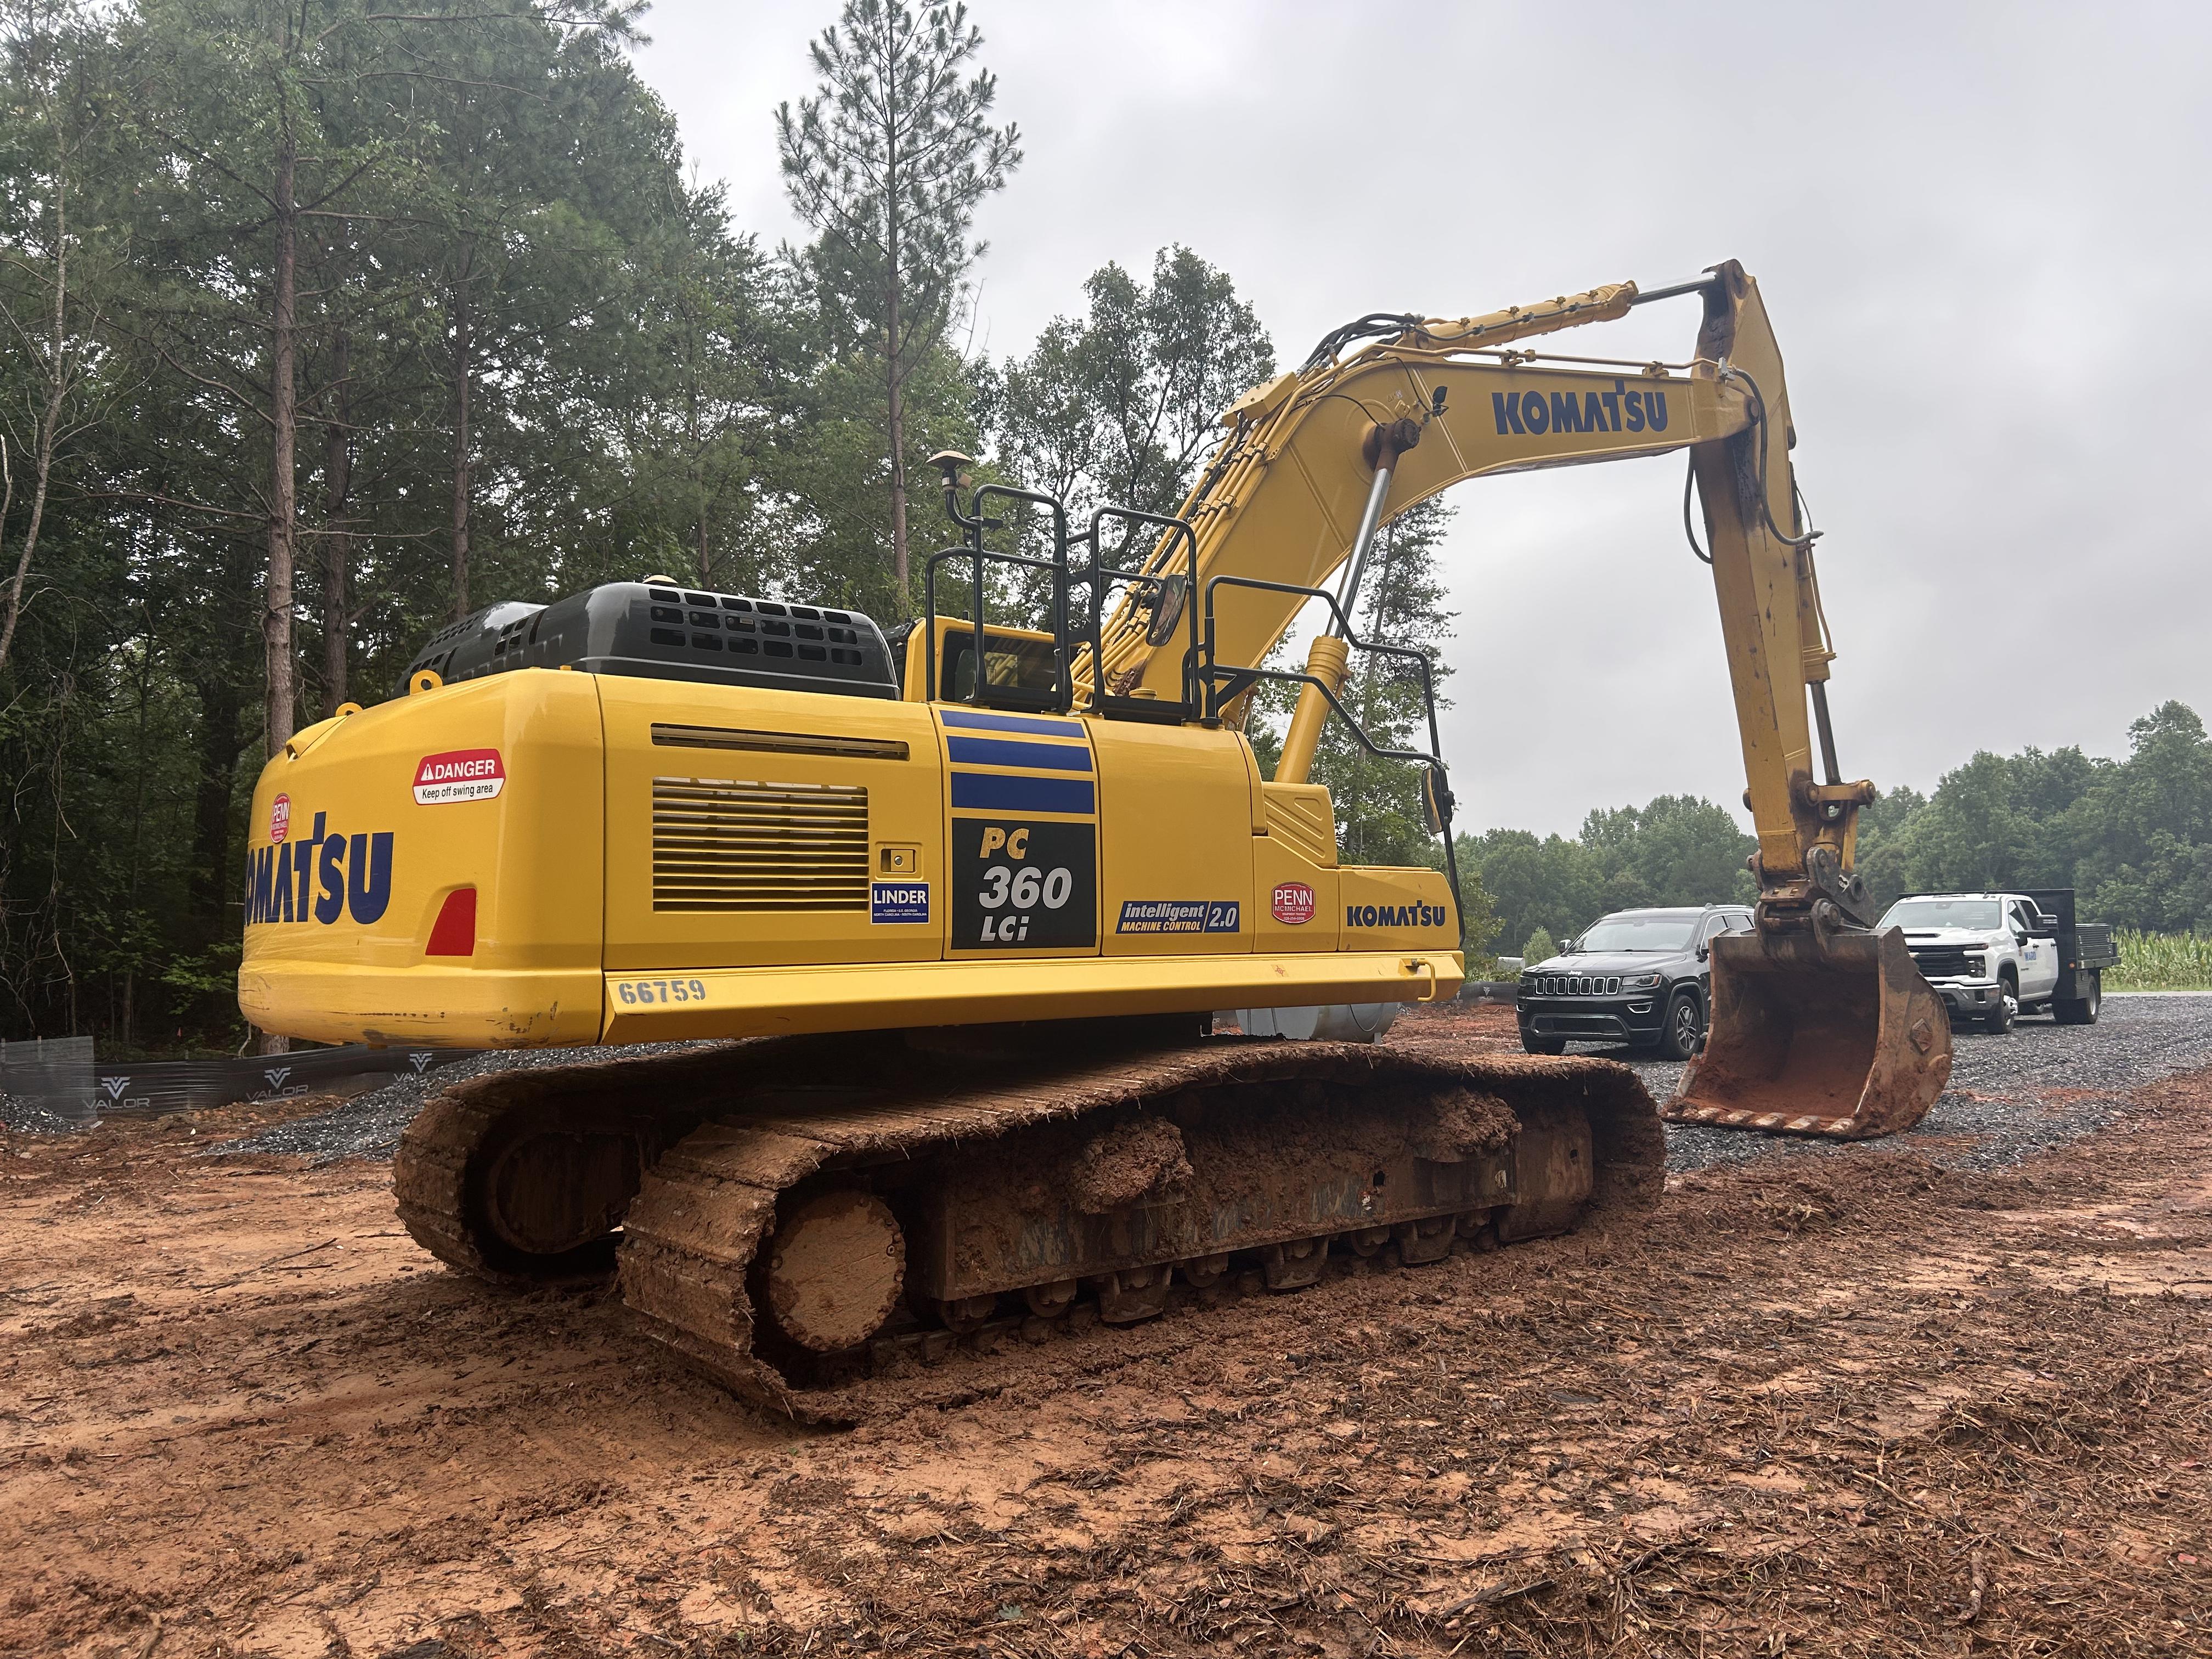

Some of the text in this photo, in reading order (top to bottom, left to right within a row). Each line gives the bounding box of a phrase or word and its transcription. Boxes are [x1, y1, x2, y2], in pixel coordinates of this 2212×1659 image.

[1492, 380, 1668, 435] KOMATSU
[434, 759, 495, 780] DANGER
[422, 785, 493, 800] Keep off swing area
[273, 802, 290, 822] PENN
[979, 827, 1029, 860] PC
[246, 811, 394, 926] OMATSU
[874, 890, 927, 904] LINDER
[979, 866, 1072, 909] 360
[1274, 889, 1312, 906] PENN
[1125, 903, 1237, 927] intelligent 2.0
[1347, 900, 1445, 927] KOMATSU
[980, 916, 1029, 941] LCi
[1121, 922, 1200, 931] MACHINE CONTROL
[619, 980, 706, 1004] 66759
[82, 1098, 150, 1109] VALOR
[246, 1085, 308, 1101] VALOR
